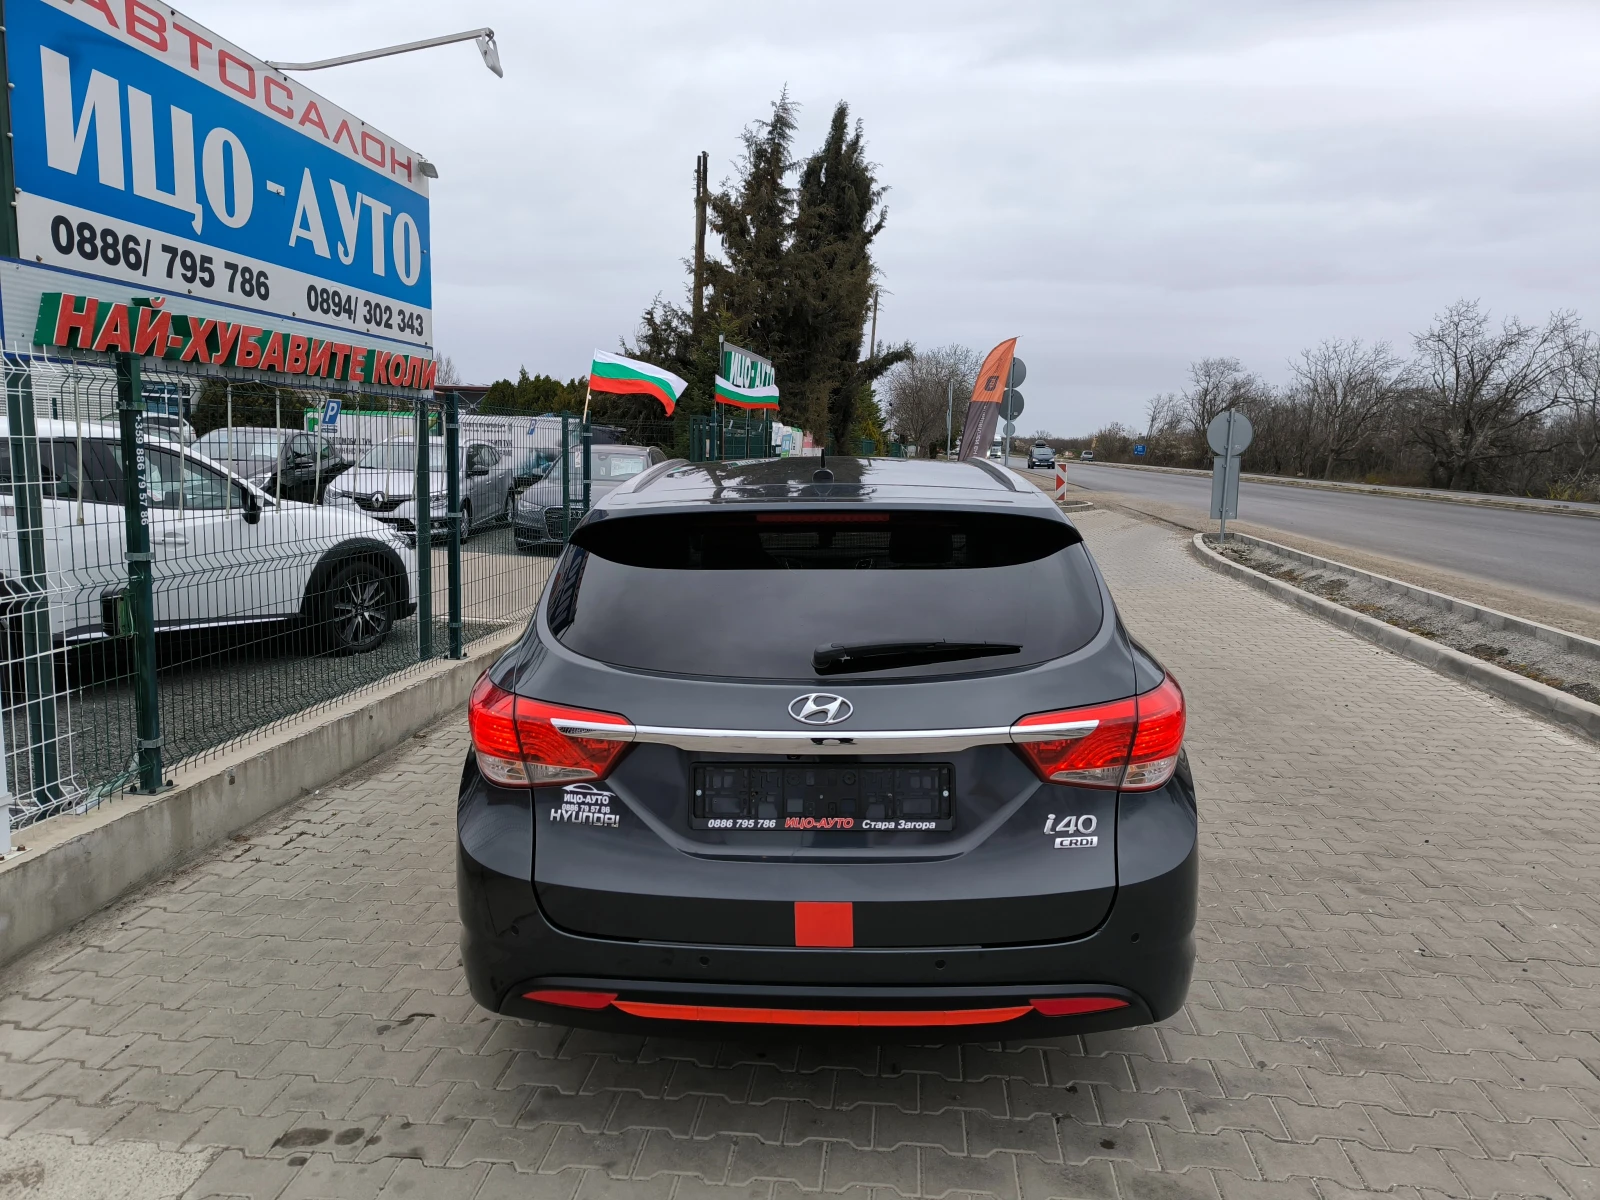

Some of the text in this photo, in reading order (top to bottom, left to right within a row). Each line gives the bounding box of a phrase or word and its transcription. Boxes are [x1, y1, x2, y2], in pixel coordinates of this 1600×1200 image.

[51, 215, 270, 301] 0886/ 795 786
[306, 284, 424, 337] 0894/ 302 343
[53, 292, 437, 390] НАЙ-ХУБАВИТЕ КОЛИ
[135, 414, 149, 526] +359 886 79 57 86
[562, 804, 578, 812] 0886
[564, 794, 609, 804] ИЦО-АУТО
[550, 808, 620, 828] HYUNDAI
[708, 817, 936, 830] 0886 795 786 ИЦО-АУТО Стара Загора
[1043, 813, 1097, 834] i40
[1059, 838, 1094, 846] CRDi
